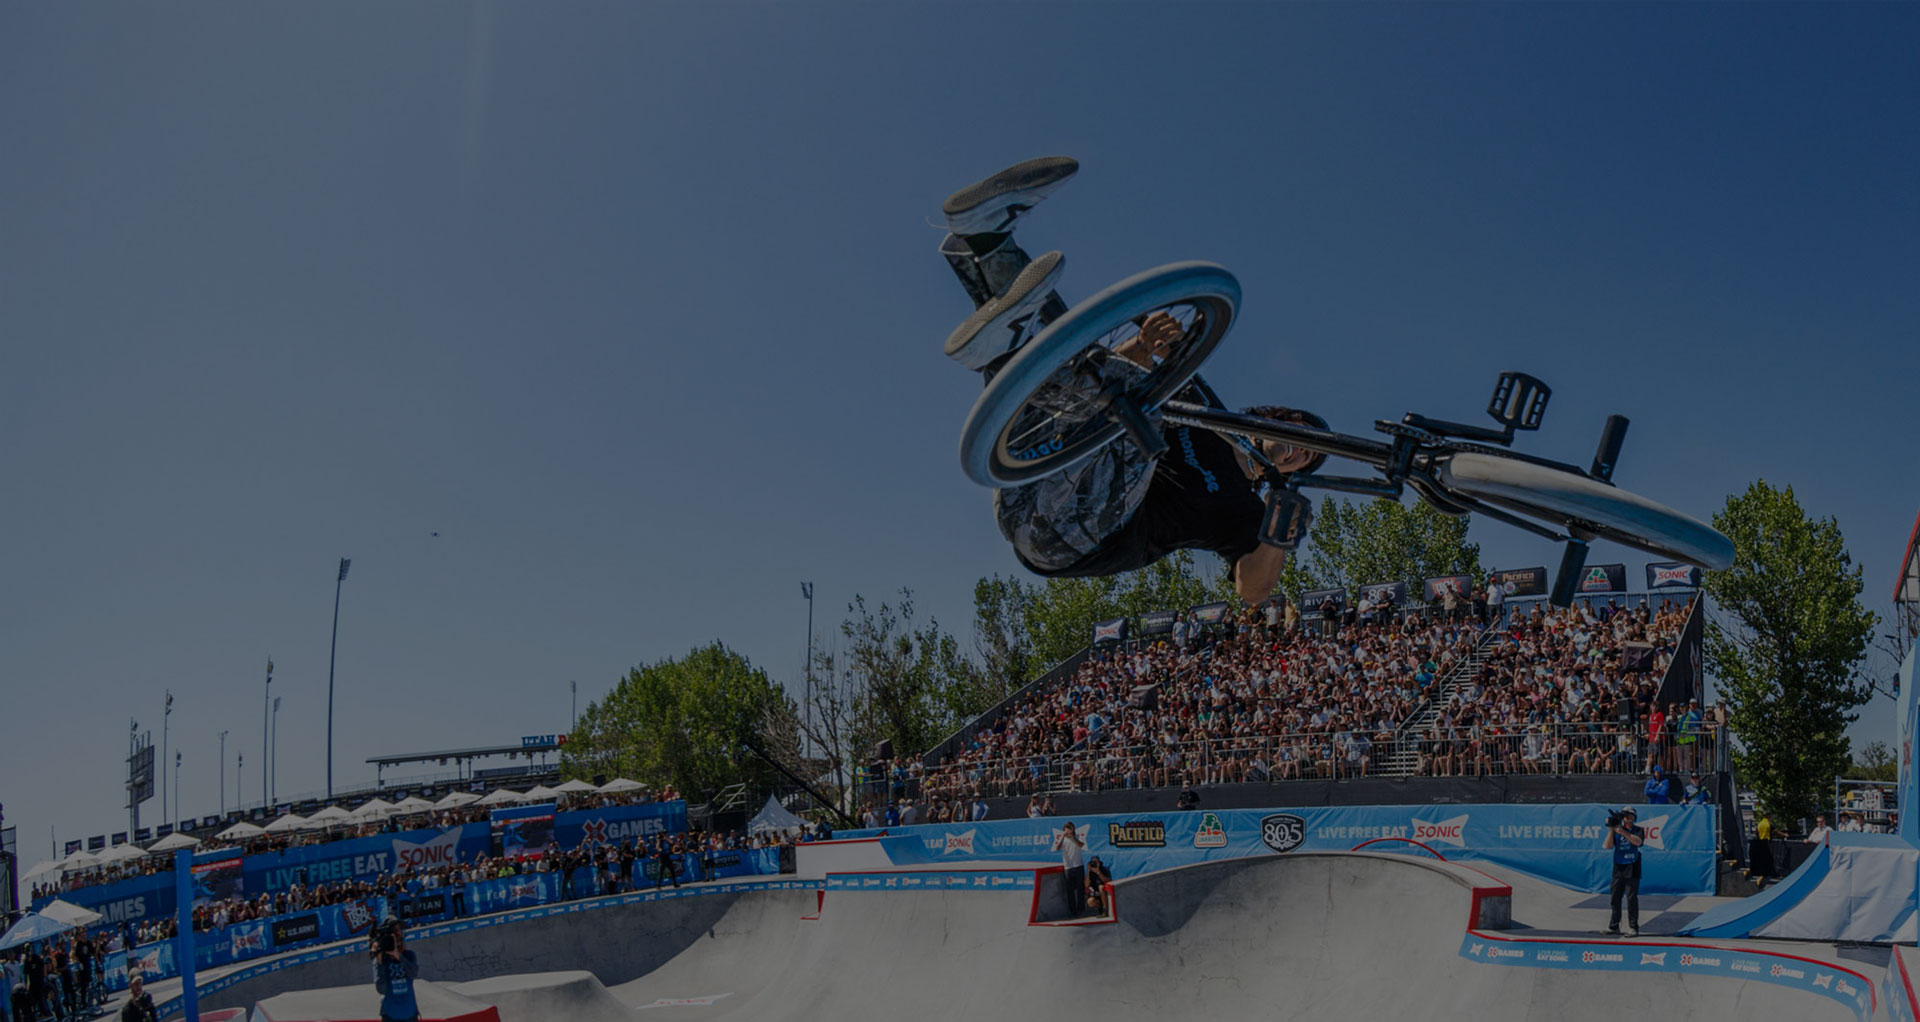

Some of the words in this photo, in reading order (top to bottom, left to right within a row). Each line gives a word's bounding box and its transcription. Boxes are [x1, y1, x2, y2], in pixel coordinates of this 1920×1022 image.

[1658, 571, 1688, 580] SONIC
[522, 734, 556, 747] UTAH
[608, 817, 665, 839] GAMES
[1109, 823, 1165, 844] PACIFICO
[1264, 823, 1303, 843] 805
[1318, 827, 1348, 839] LIVE
[1348, 826, 1380, 838] FREE
[1381, 826, 1408, 839] EAT
[1416, 825, 1461, 838] SONIC
[1499, 825, 1532, 838] LIVE
[1534, 825, 1570, 838] FREE
[1572, 825, 1602, 839] EAT
[930, 838, 944, 849] EAT
[947, 837, 972, 848] SONIC
[992, 836, 1013, 847] LIVE
[1013, 836, 1033, 846] FREE
[1033, 835, 1050, 845] EAT
[309, 858, 351, 883] FREE
[354, 852, 388, 875] EAT
[398, 843, 454, 868] SONIC
